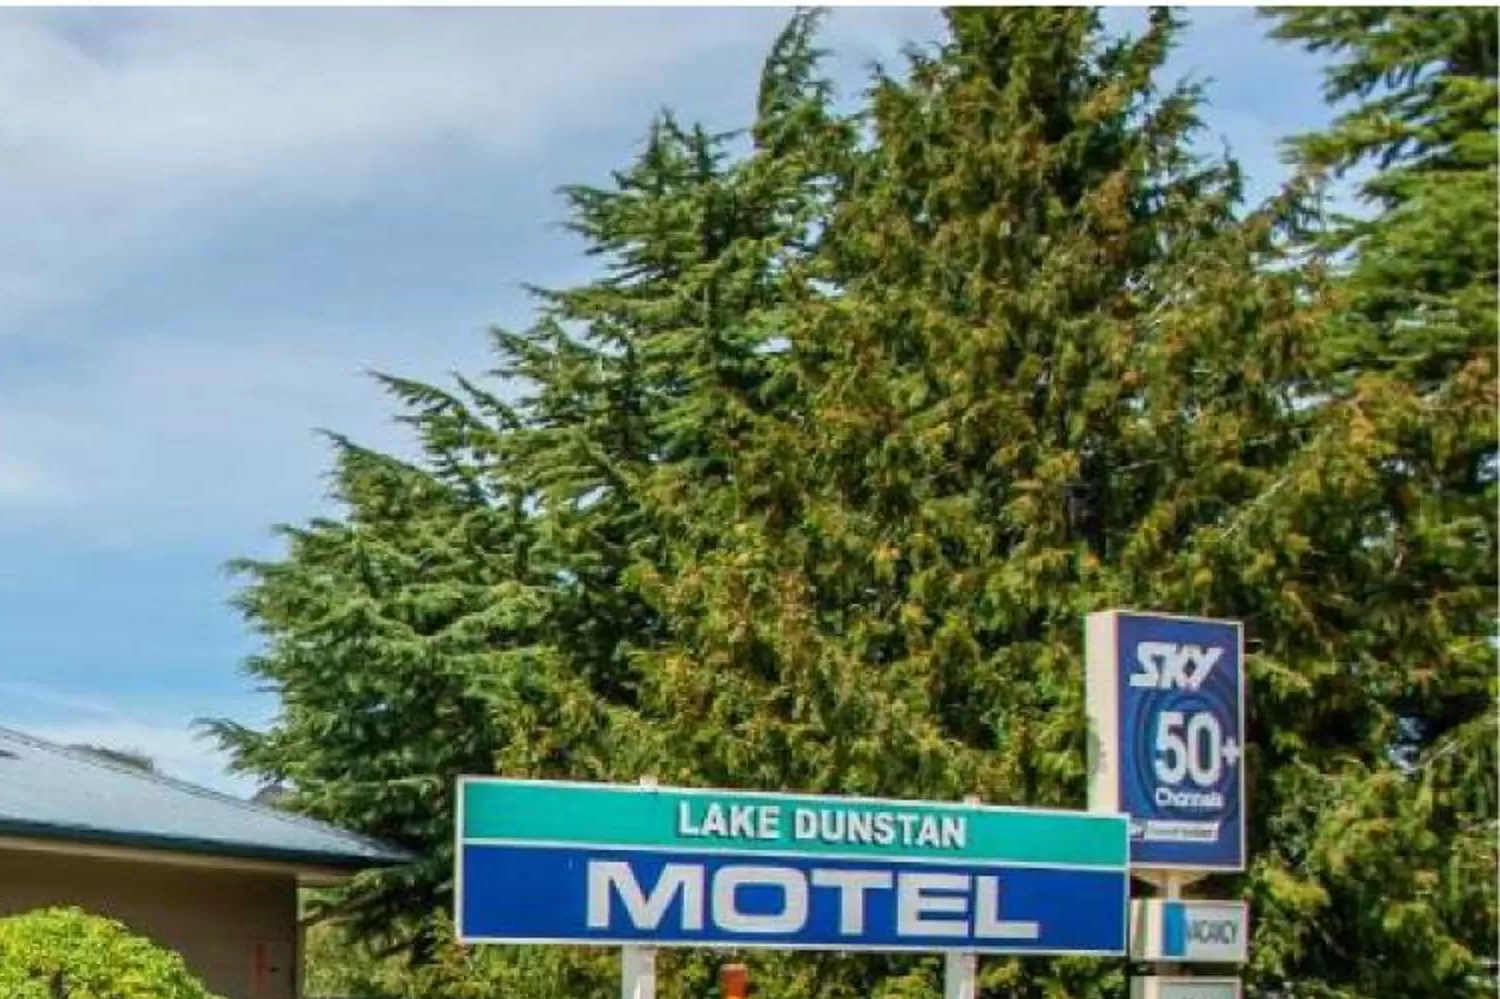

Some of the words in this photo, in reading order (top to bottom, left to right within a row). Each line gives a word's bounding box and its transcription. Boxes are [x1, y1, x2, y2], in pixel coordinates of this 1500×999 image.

[1129, 641, 1224, 690] SKY
[678, 800, 781, 841] LAKE
[795, 807, 968, 848] DUNSTAN
[587, 861, 1040, 938] MOTEL
